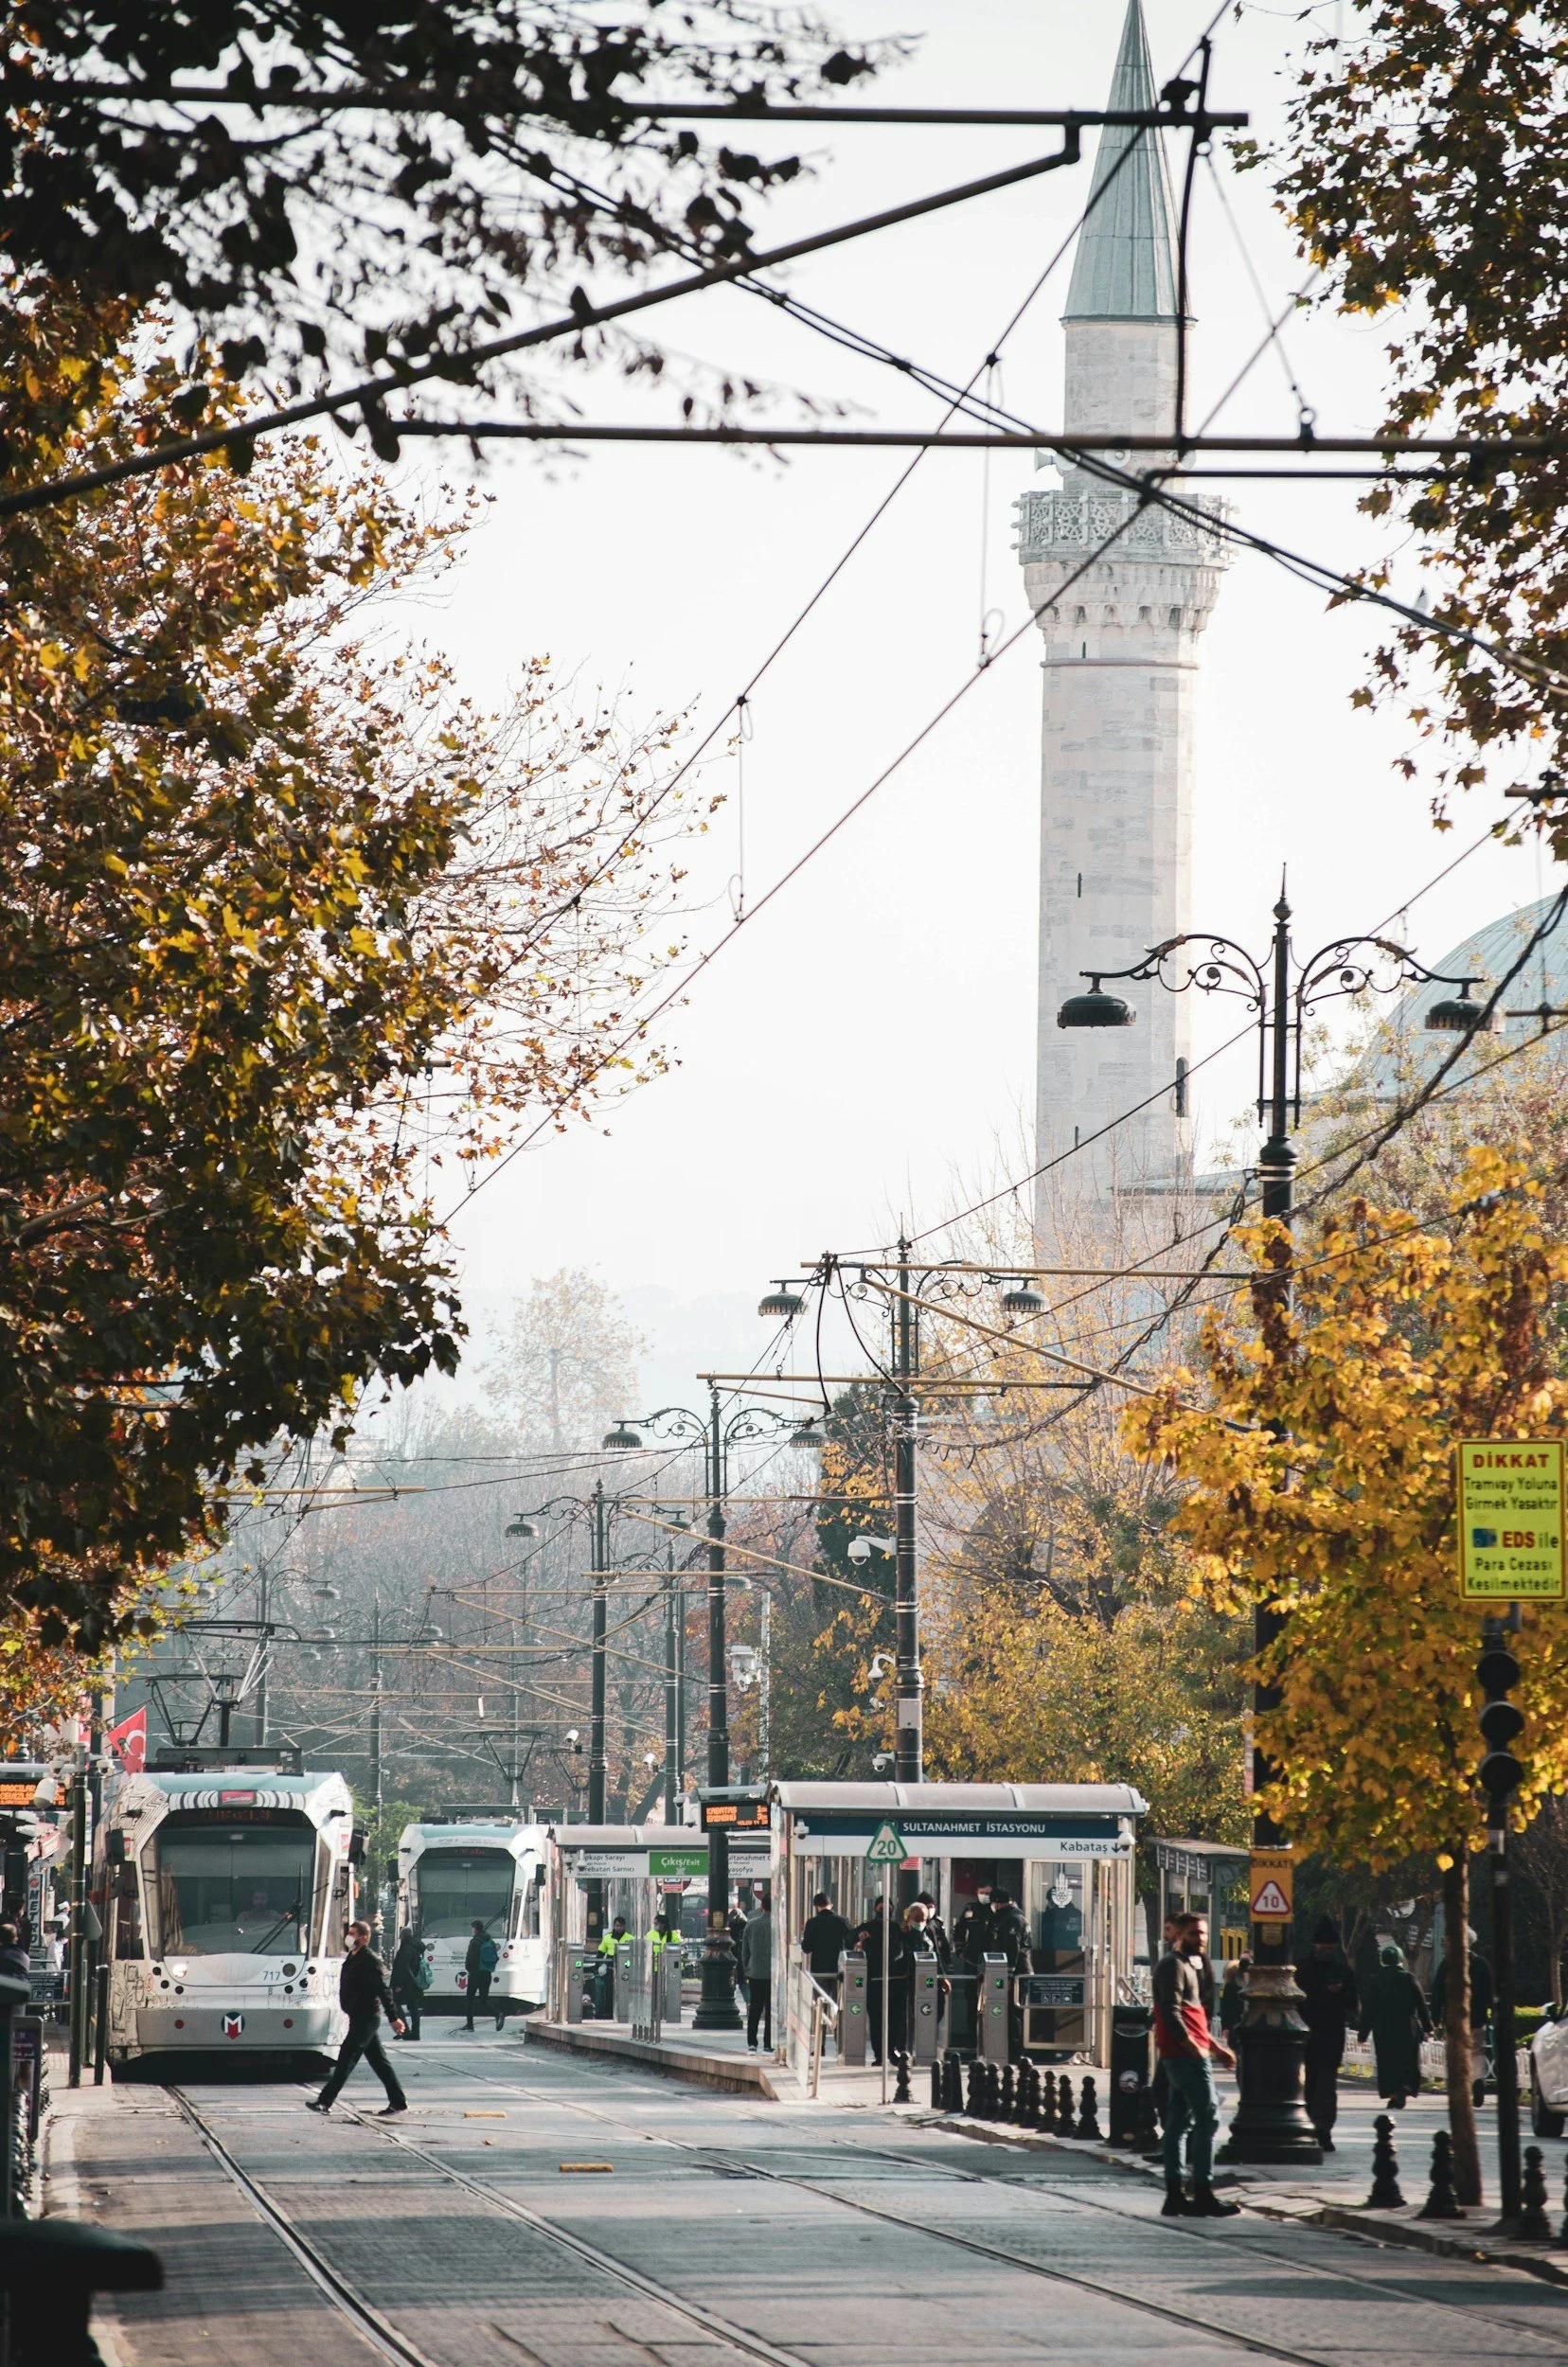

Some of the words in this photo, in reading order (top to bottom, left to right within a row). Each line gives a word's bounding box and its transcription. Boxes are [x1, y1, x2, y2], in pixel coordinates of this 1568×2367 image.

[1473, 1451, 1549, 1468] DİKKAT
[1465, 1477, 1514, 1493] Tramvay
[1517, 1477, 1558, 1490] Yoluna
[1467, 1497, 1507, 1509] Girmek
[1510, 1496, 1559, 1510] Yasaktır
[1503, 1530, 1535, 1549] EDS
[1538, 1531, 1559, 1549] ile
[1475, 1557, 1505, 1571] Para
[1510, 1557, 1552, 1571] Cezası
[1468, 1577, 1559, 1590] Kesilmektedir
[902, 1823, 981, 1832] SULTANAHMET
[986, 1822, 1046, 1833] İSTASYONU
[877, 1841, 897, 1856] 20
[1060, 1842, 1108, 1854] Kabataş
[661, 1858, 701, 1868] Çıkış/Exit
[1263, 1896, 1279, 1909] 10
[263, 1971, 281, 1982] 717
